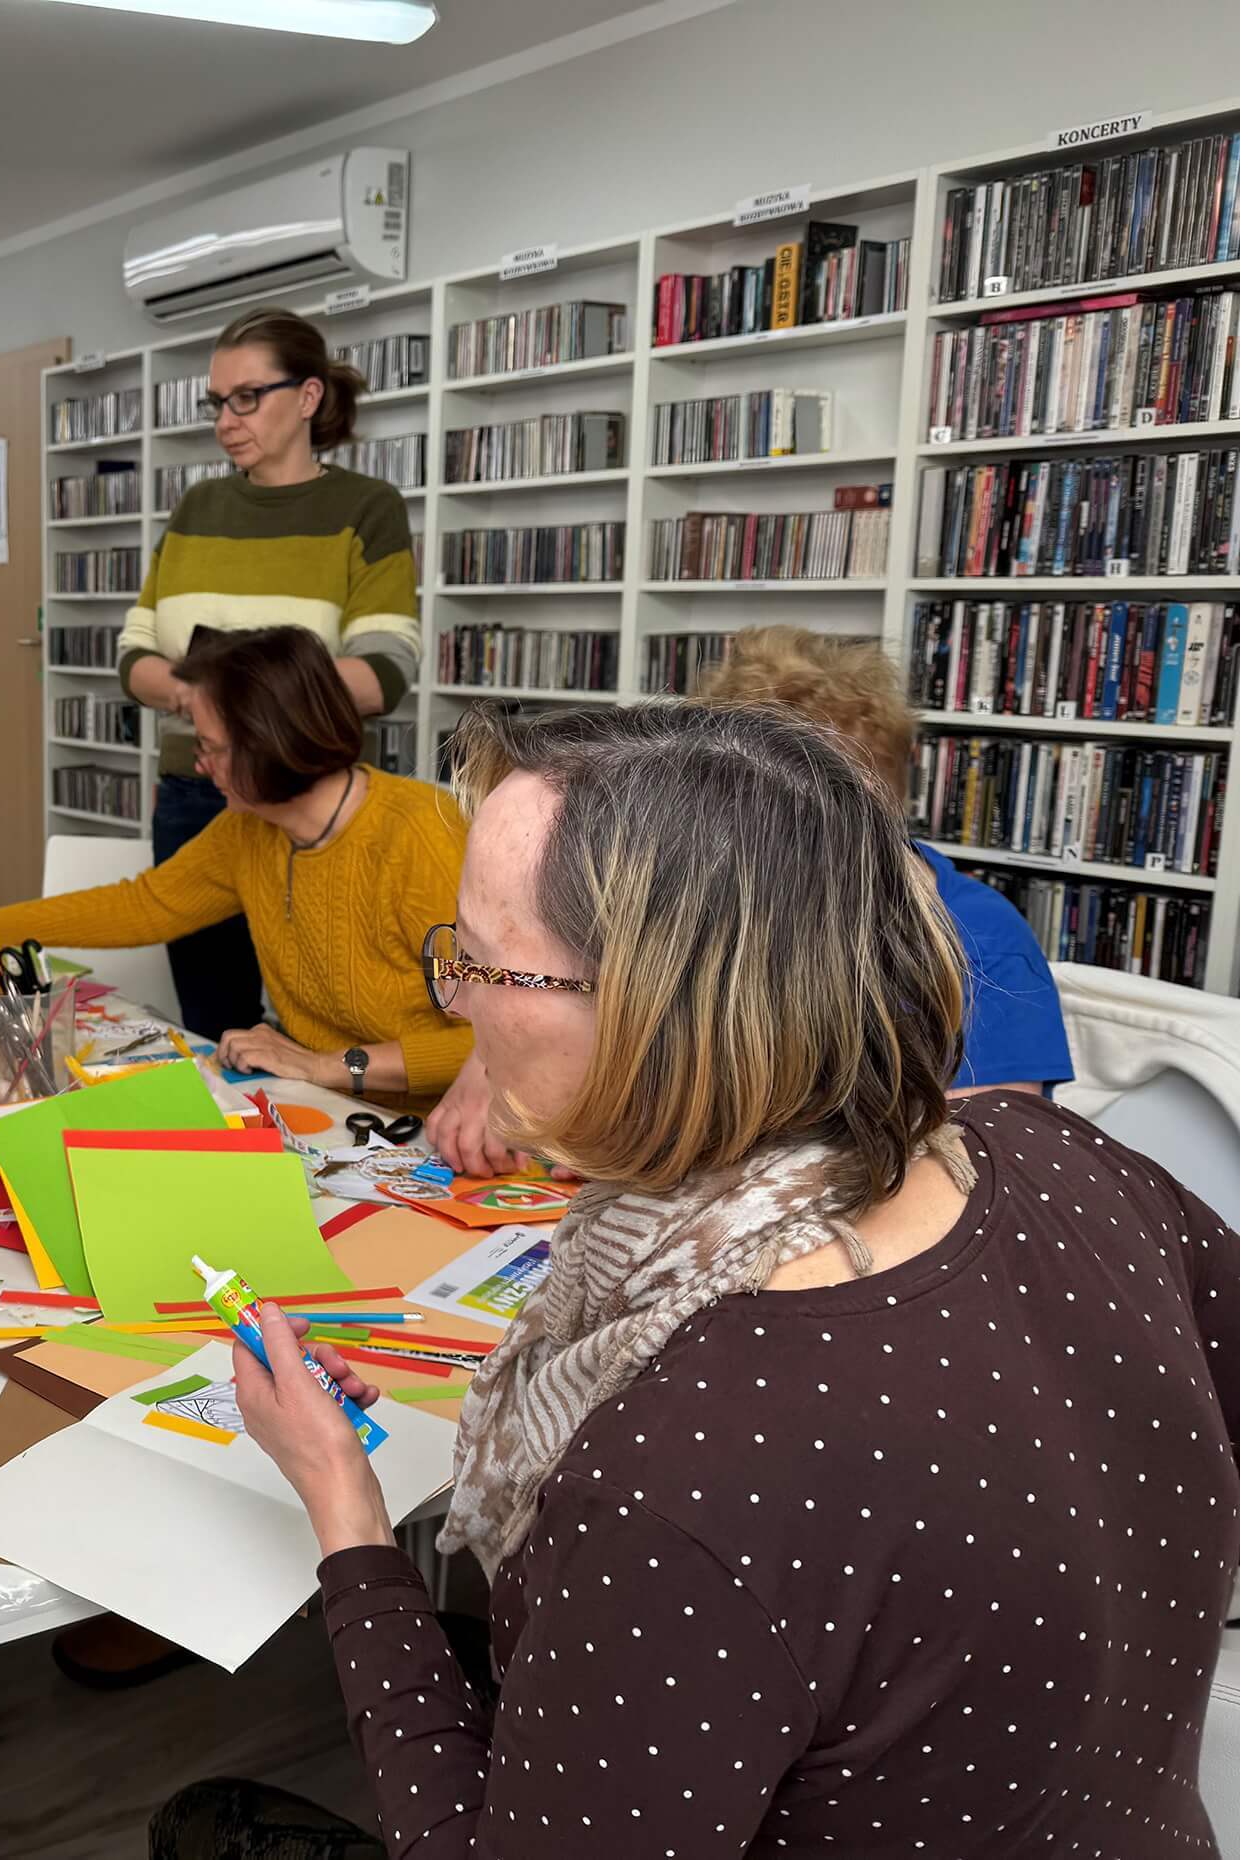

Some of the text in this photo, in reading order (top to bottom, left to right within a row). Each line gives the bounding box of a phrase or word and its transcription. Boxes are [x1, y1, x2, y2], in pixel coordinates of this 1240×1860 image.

[1057, 115, 1142, 146] KONCERTY
[991, 281, 1001, 293] B
[1141, 412, 1153, 424] D
[1150, 855, 1162, 867] P
